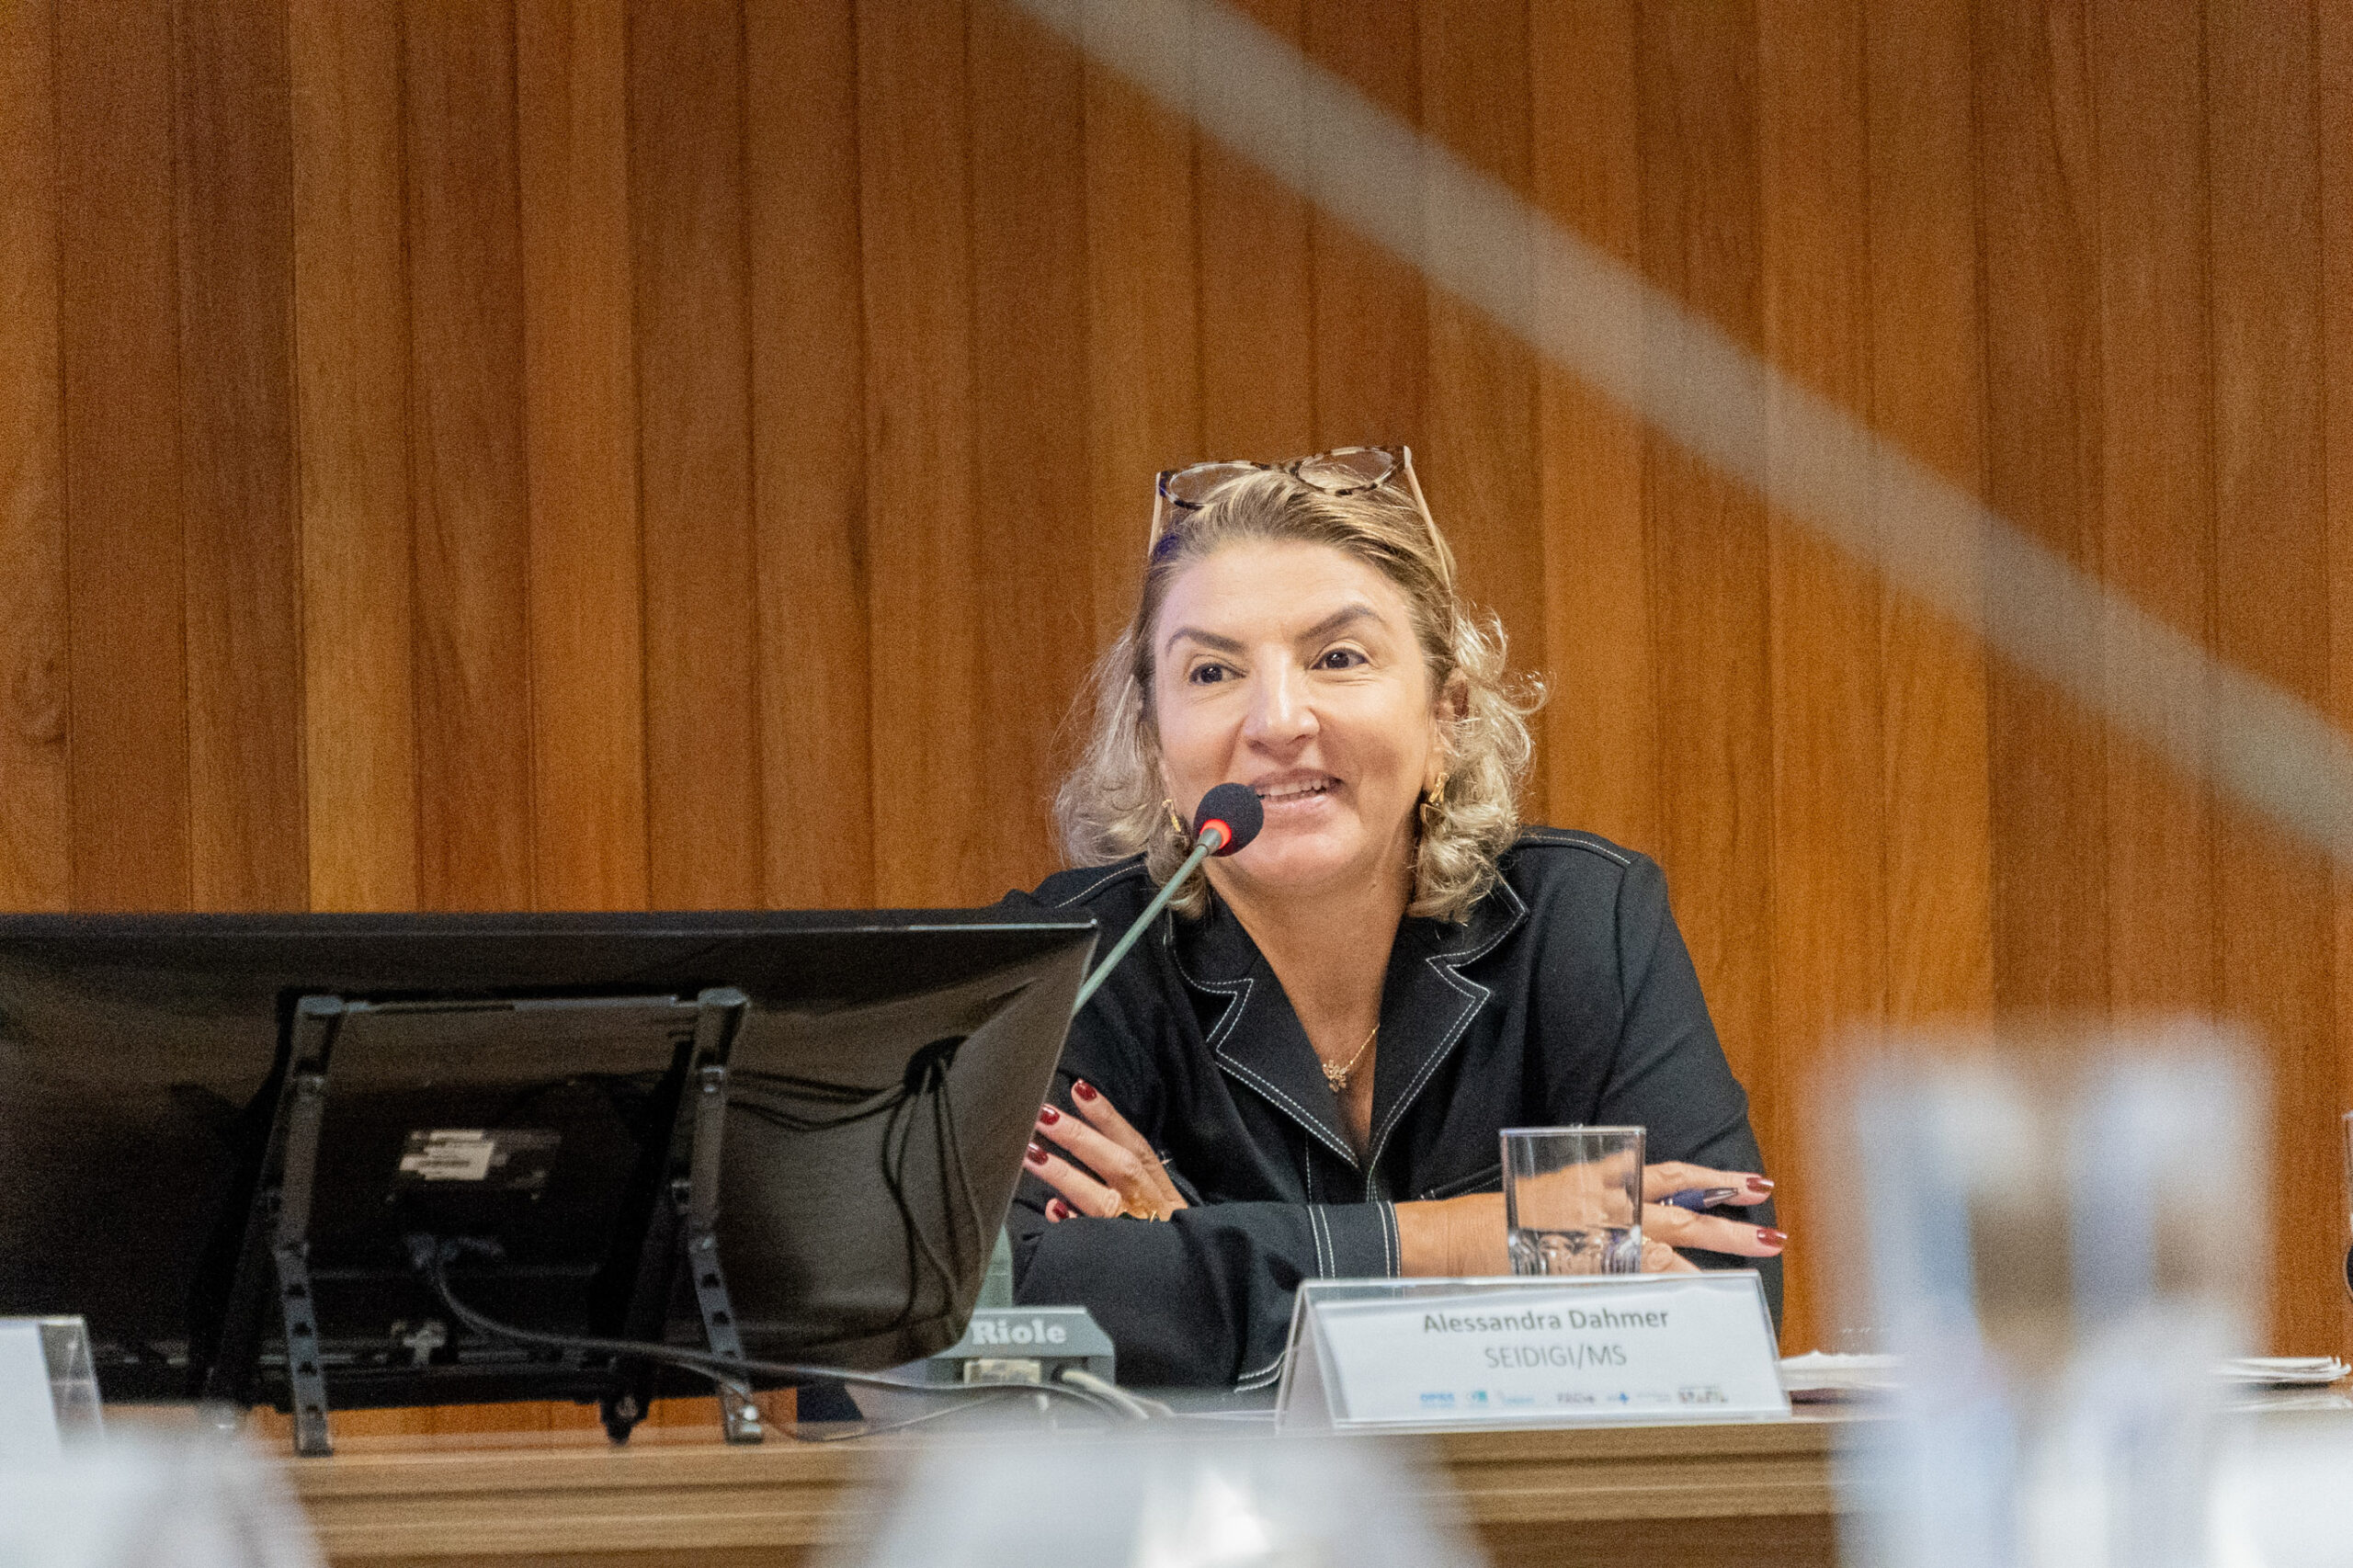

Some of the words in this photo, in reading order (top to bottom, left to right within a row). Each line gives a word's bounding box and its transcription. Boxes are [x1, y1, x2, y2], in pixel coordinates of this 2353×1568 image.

[970, 1319, 1067, 1345] Riole
[1424, 1311, 1562, 1333] Alessandra
[1568, 1308, 1669, 1330] Dahmer
[1484, 1345, 1628, 1369] SEIDIGI/MS
